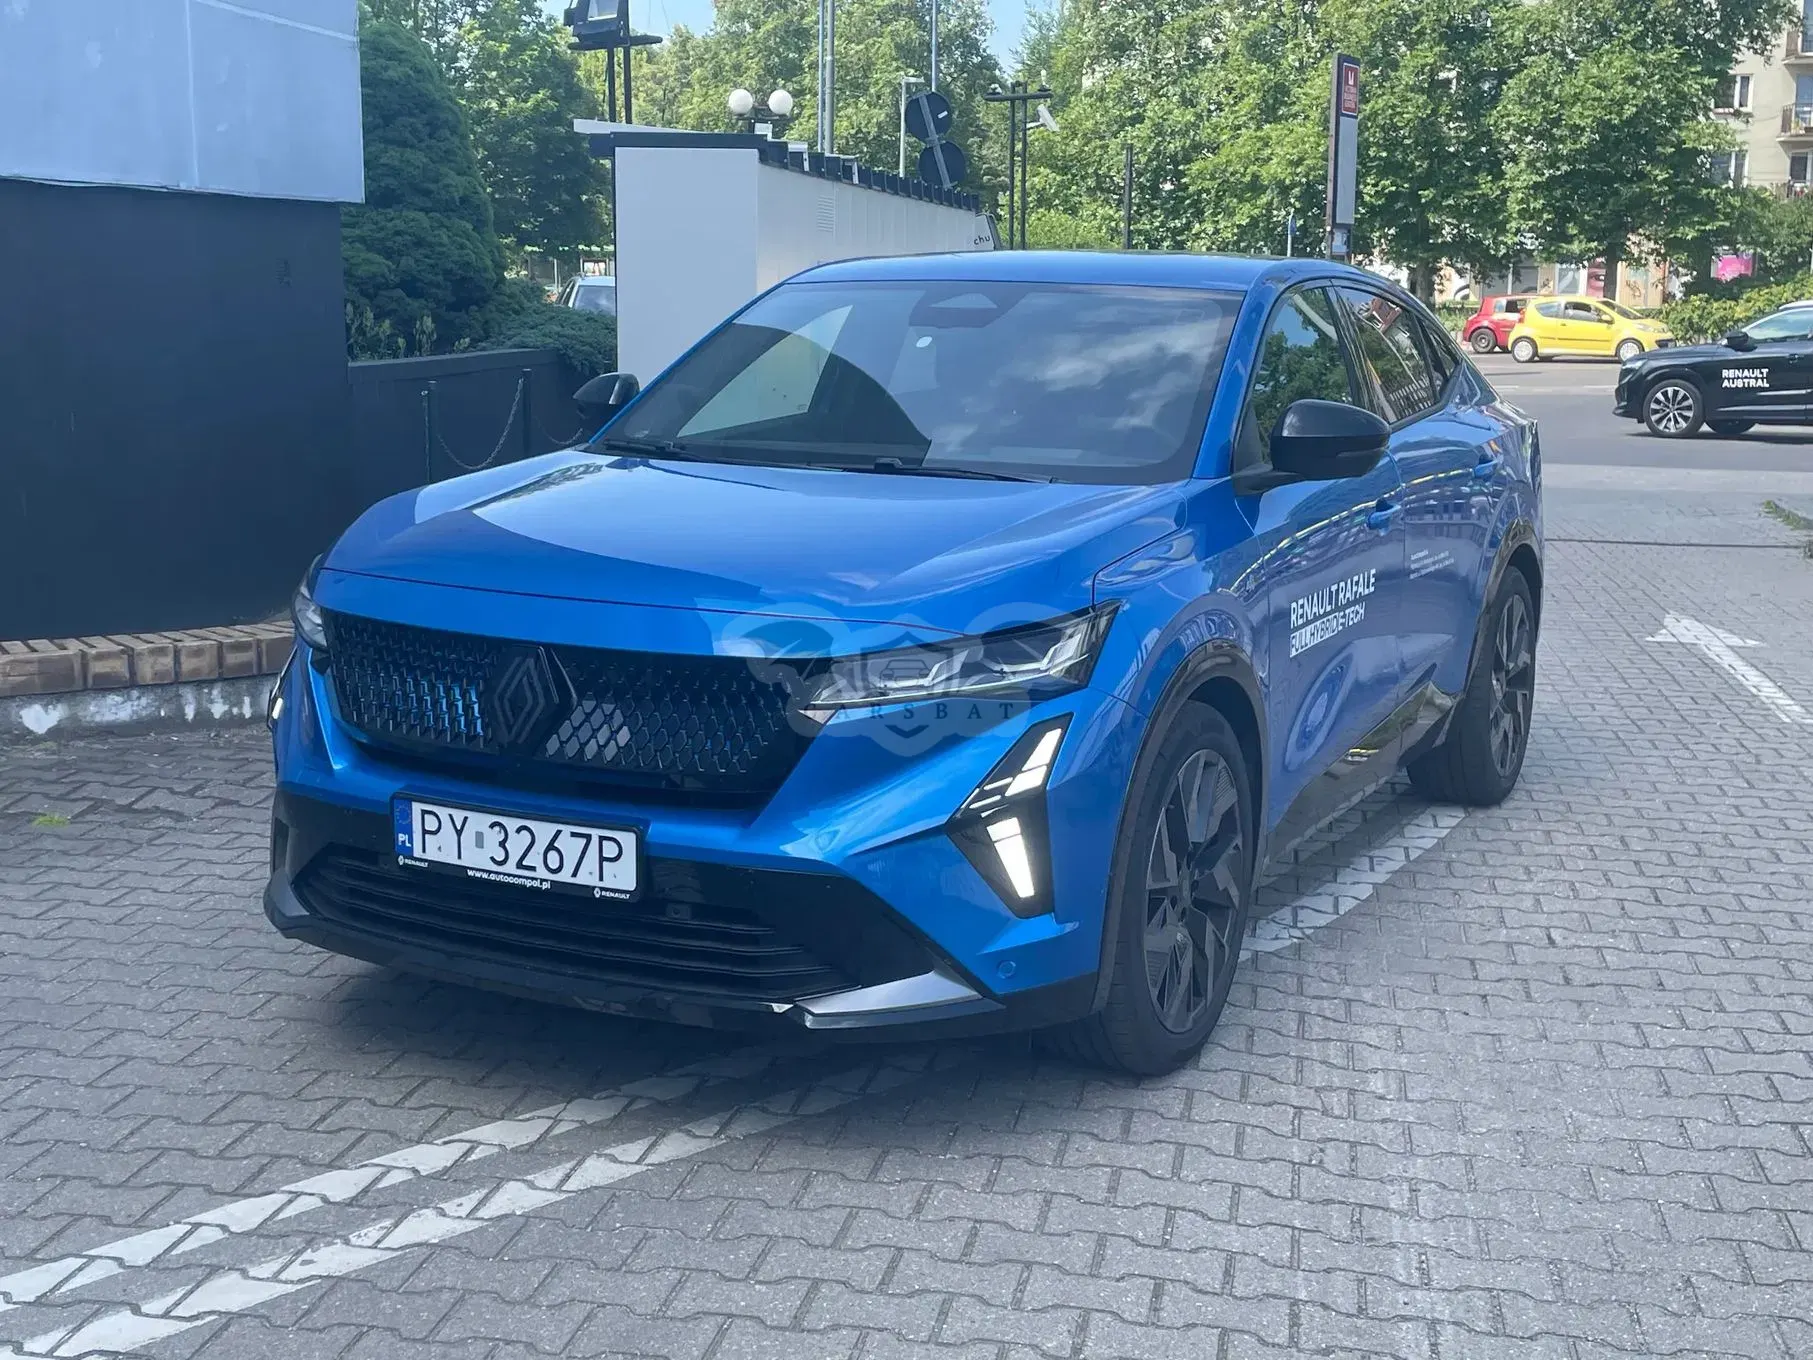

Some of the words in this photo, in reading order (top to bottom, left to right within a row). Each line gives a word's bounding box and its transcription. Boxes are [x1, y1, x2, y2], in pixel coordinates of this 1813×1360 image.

[1722, 368, 1769, 378] RENAULT
[1722, 379, 1769, 388] AUSTRAL
[1290, 584, 1339, 628] RENAULT
[1338, 569, 1377, 606] RAFALE
[1290, 627, 1310, 656] FULL
[1309, 613, 1338, 644] HYBRID
[1338, 602, 1366, 630] E-TECH
[398, 833, 412, 847] PL
[420, 808, 469, 860] PY
[488, 820, 623, 882] 3267P
[404, 858, 429, 868] RENAULT
[466, 869, 551, 890] www.autocompol.pl
[601, 890, 631, 900] RENAULT
